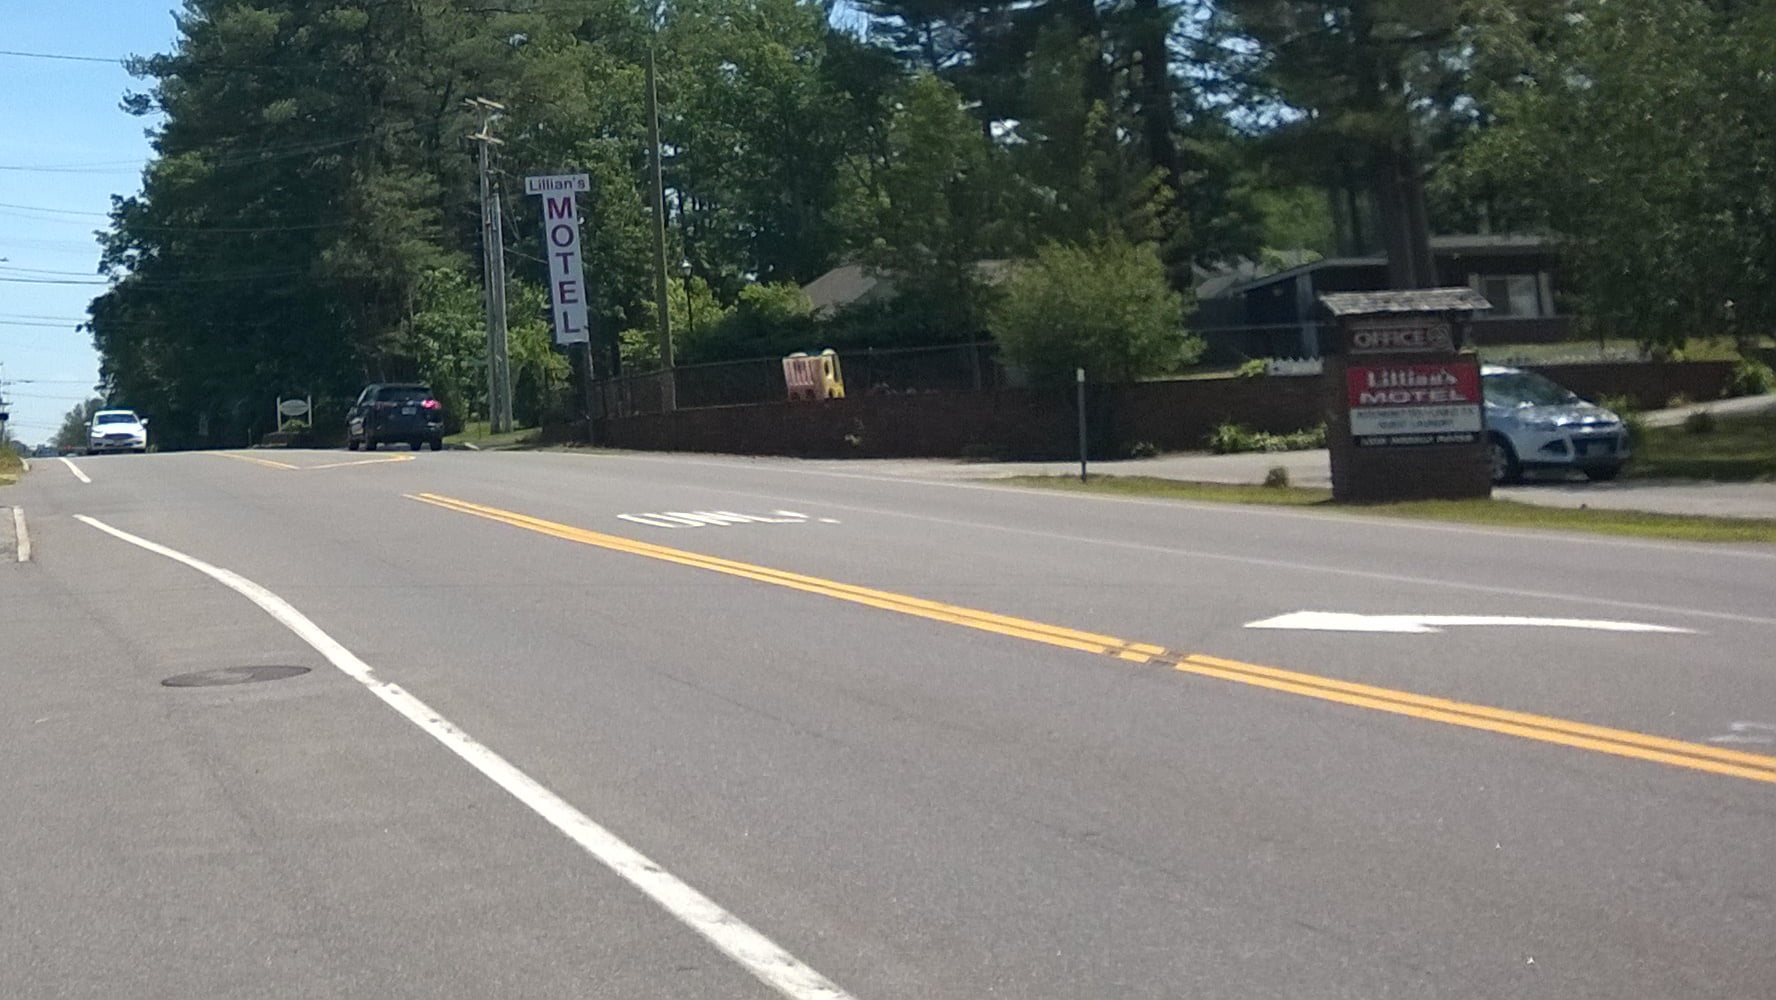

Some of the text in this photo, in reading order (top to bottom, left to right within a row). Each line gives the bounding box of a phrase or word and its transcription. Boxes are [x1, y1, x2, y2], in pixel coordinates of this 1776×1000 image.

[529, 177, 586, 191] Lillian's
[547, 197, 582, 334] MOTEL
[1353, 328, 1426, 348] OFFICE
[1367, 367, 1458, 388] Lillian's
[1359, 388, 1468, 404] MOTEL
